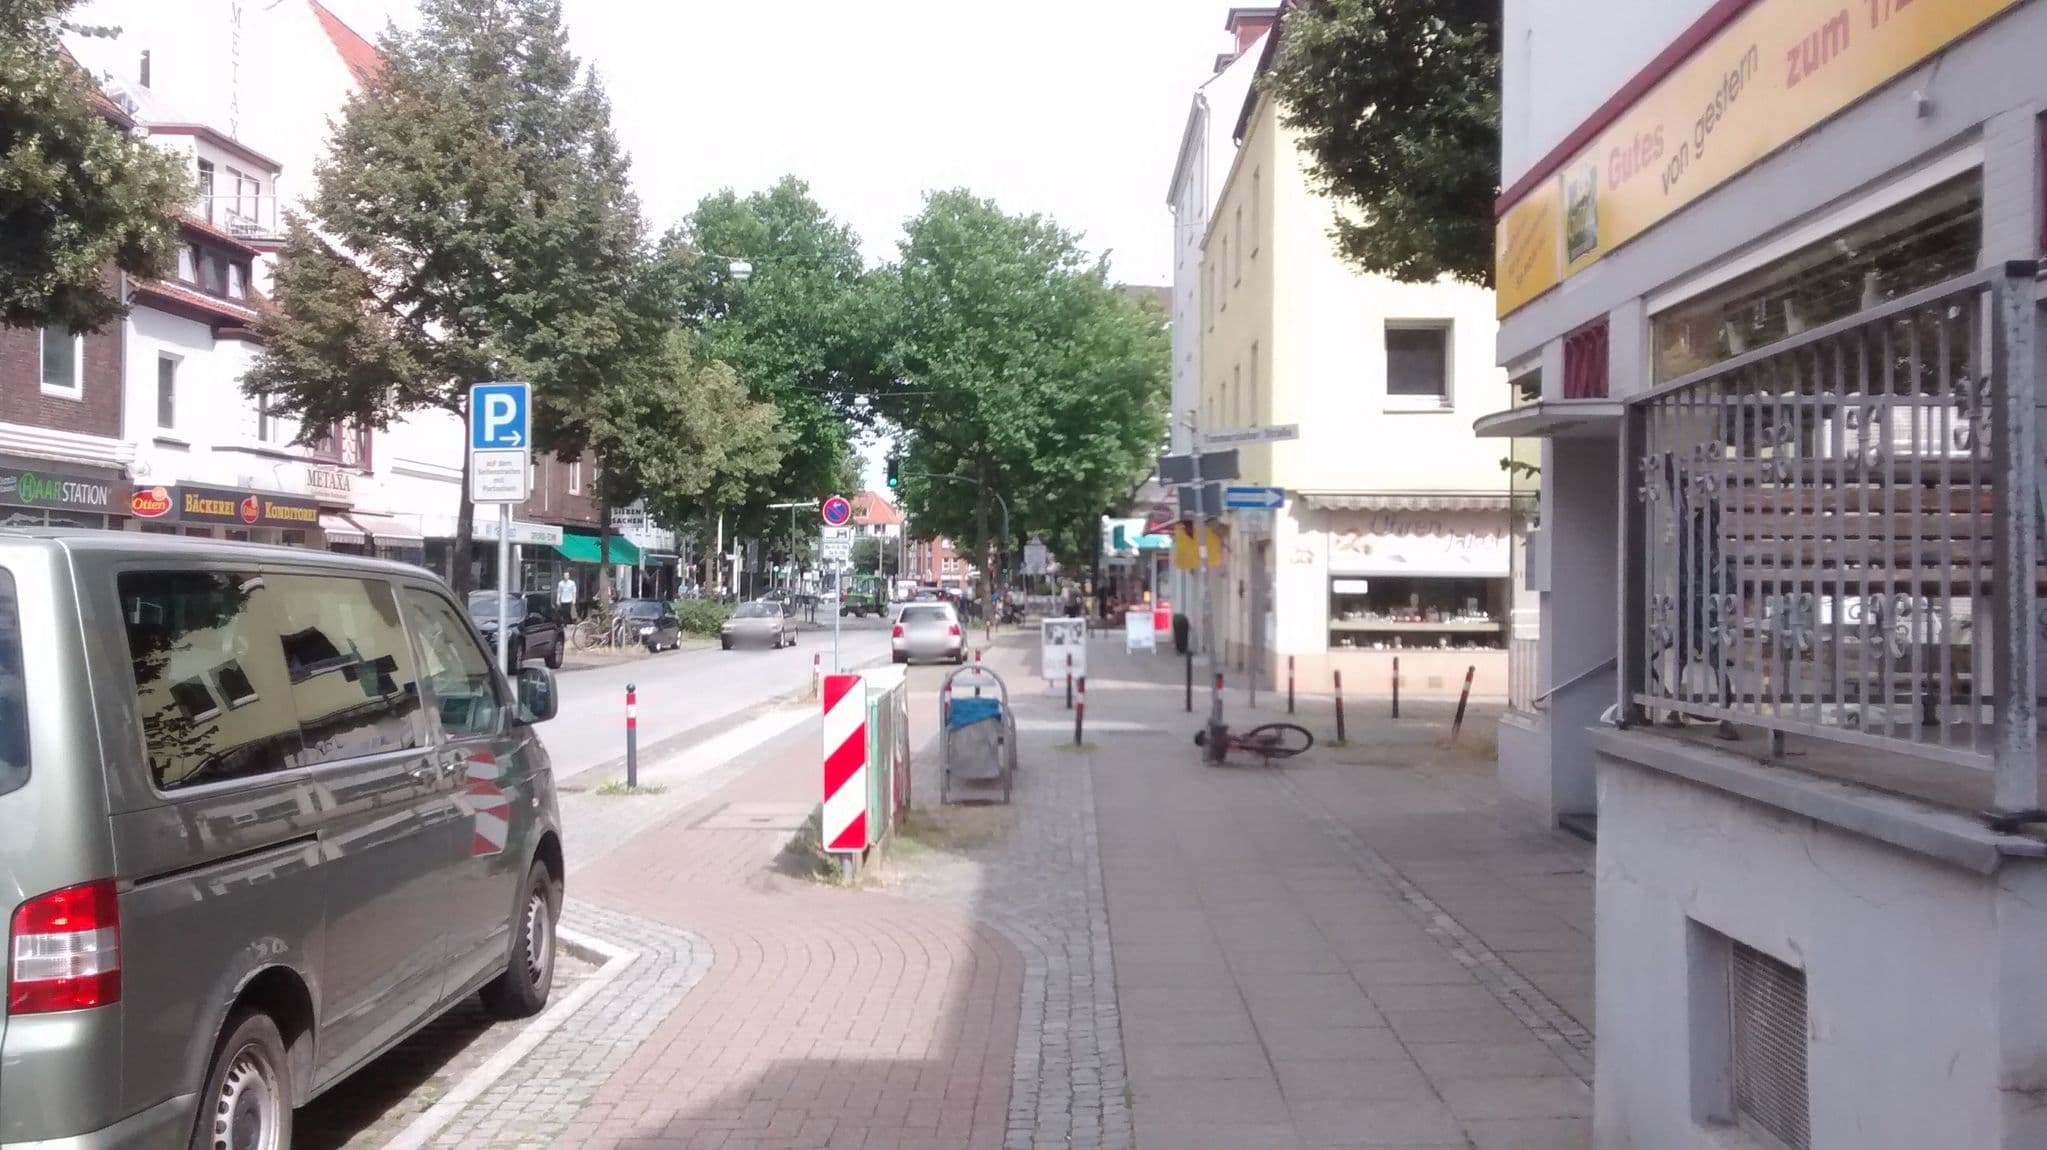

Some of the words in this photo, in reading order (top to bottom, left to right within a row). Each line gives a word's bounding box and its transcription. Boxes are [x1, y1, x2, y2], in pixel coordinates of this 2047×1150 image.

[1784, 8, 1850, 90] zum
[1660, 141, 1689, 197] von
[1693, 43, 1760, 161] gestern
[1606, 123, 1666, 192] Gutes
[484, 393, 517, 442] P
[132, 497, 166, 511] Otten
[612, 517, 643, 525] SACHEN
